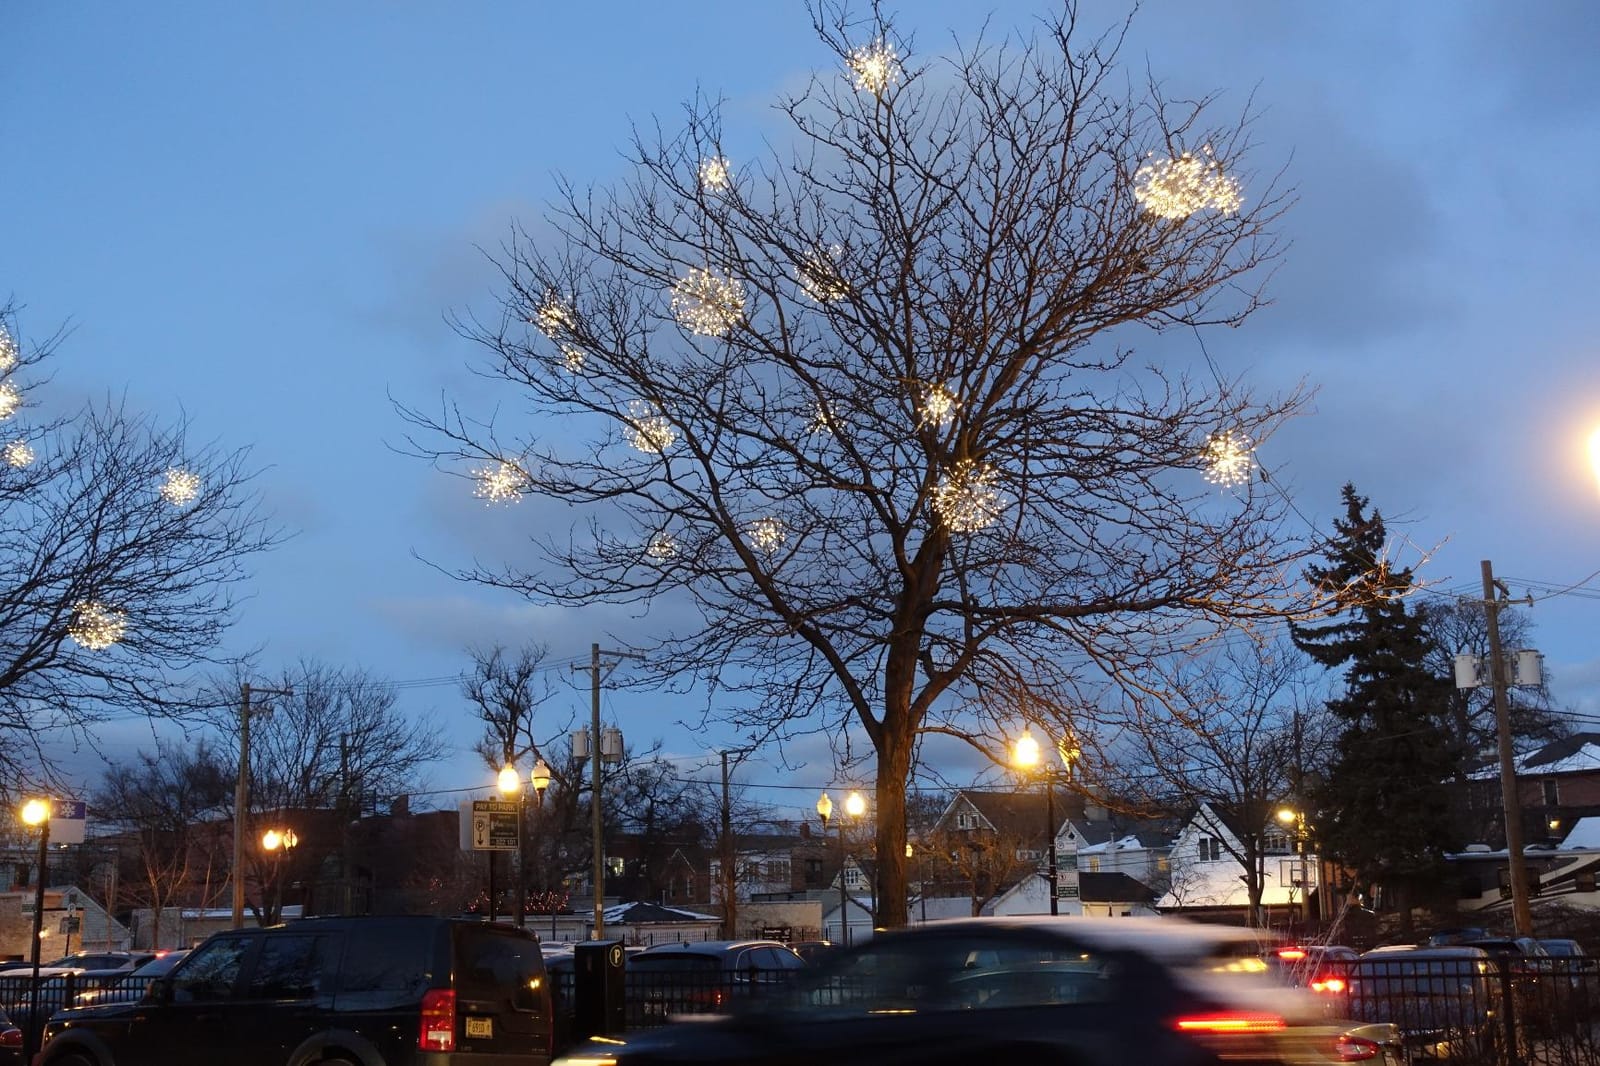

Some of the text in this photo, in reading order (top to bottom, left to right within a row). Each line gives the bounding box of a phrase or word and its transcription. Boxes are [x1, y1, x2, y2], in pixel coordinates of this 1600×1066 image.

[475, 802, 515, 812] PAY TO PARK
[614, 949, 621, 964] P
